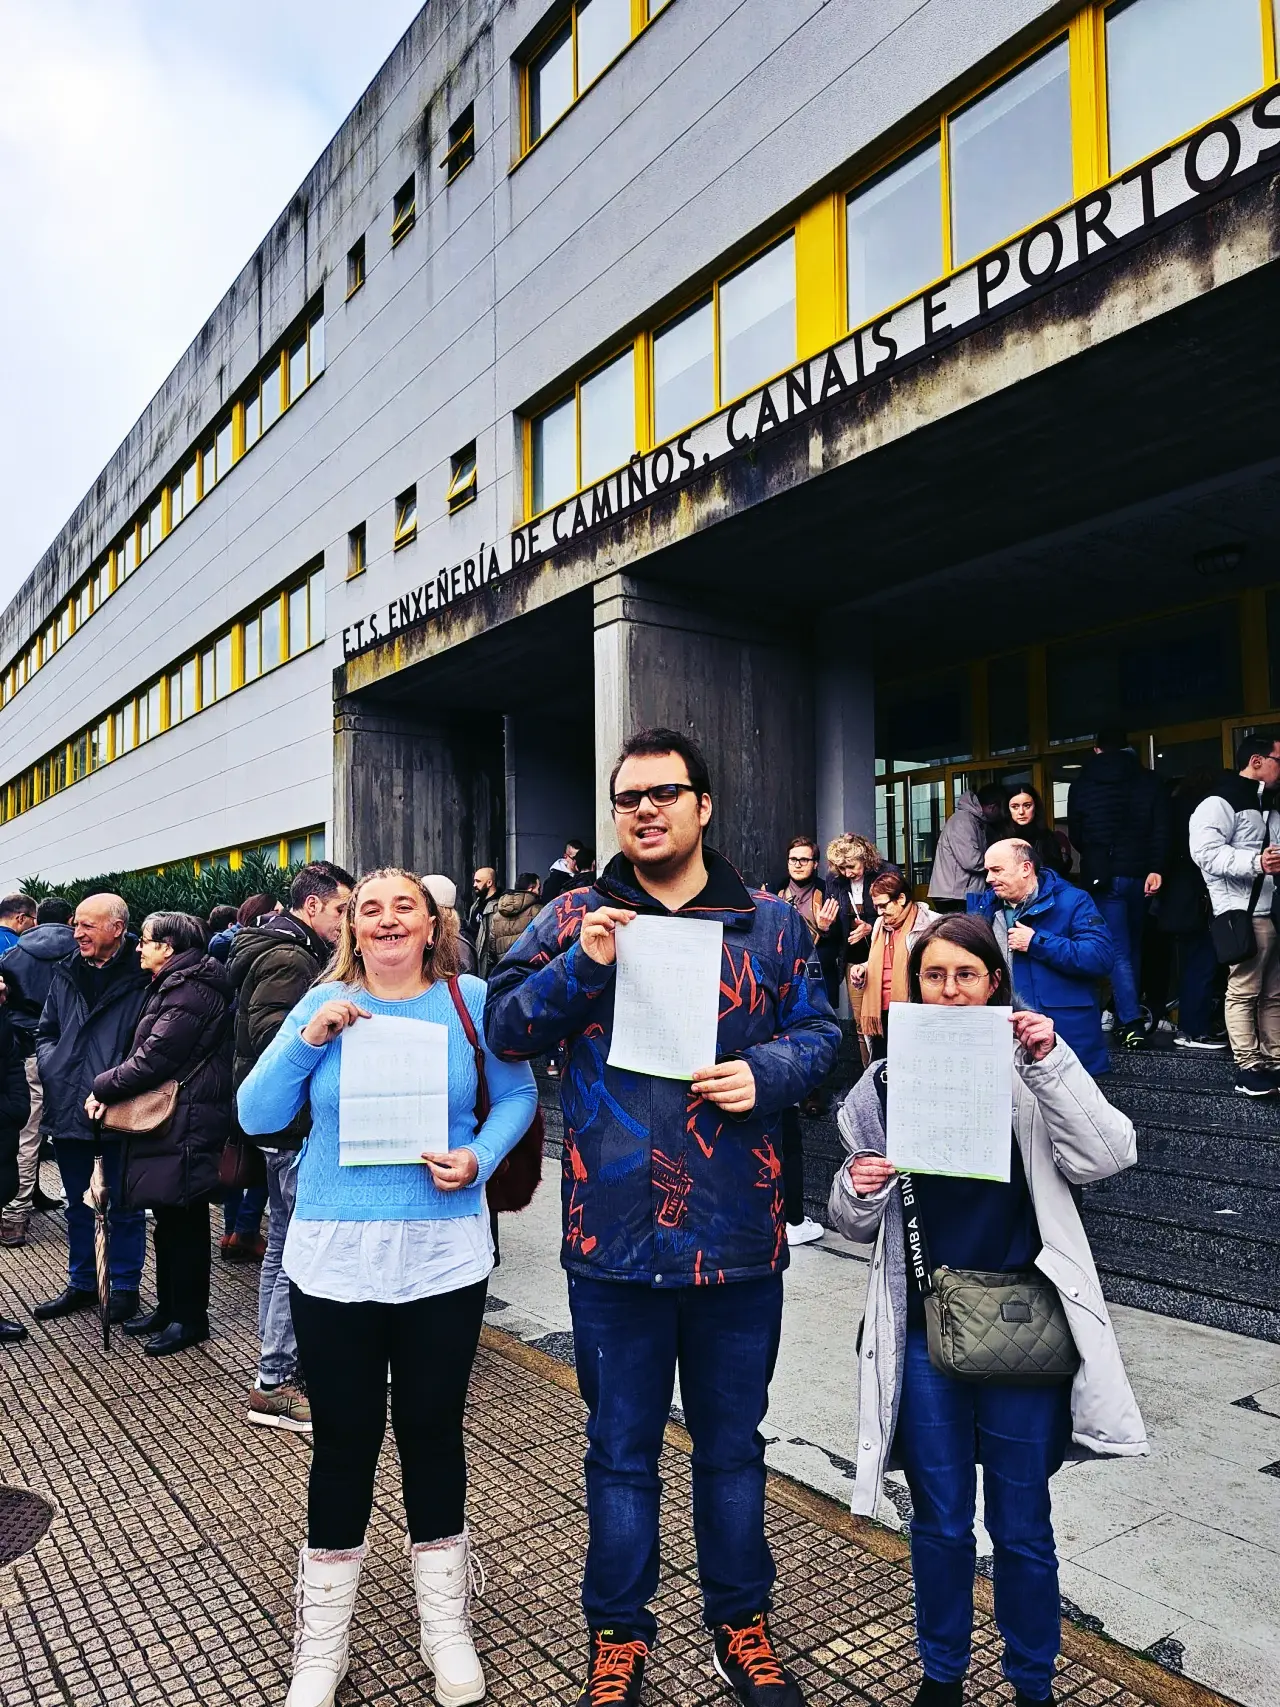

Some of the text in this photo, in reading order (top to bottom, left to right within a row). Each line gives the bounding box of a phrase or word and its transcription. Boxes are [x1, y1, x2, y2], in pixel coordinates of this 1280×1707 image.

[342, 613, 383, 658] E.T.S.
[388, 542, 501, 632] ENXEÑERÍA
[511, 520, 542, 569] DE
[726, 313, 898, 450] CANAIS
[923, 284, 952, 346] E
[907, 1216, 925, 1279] BIMBA
